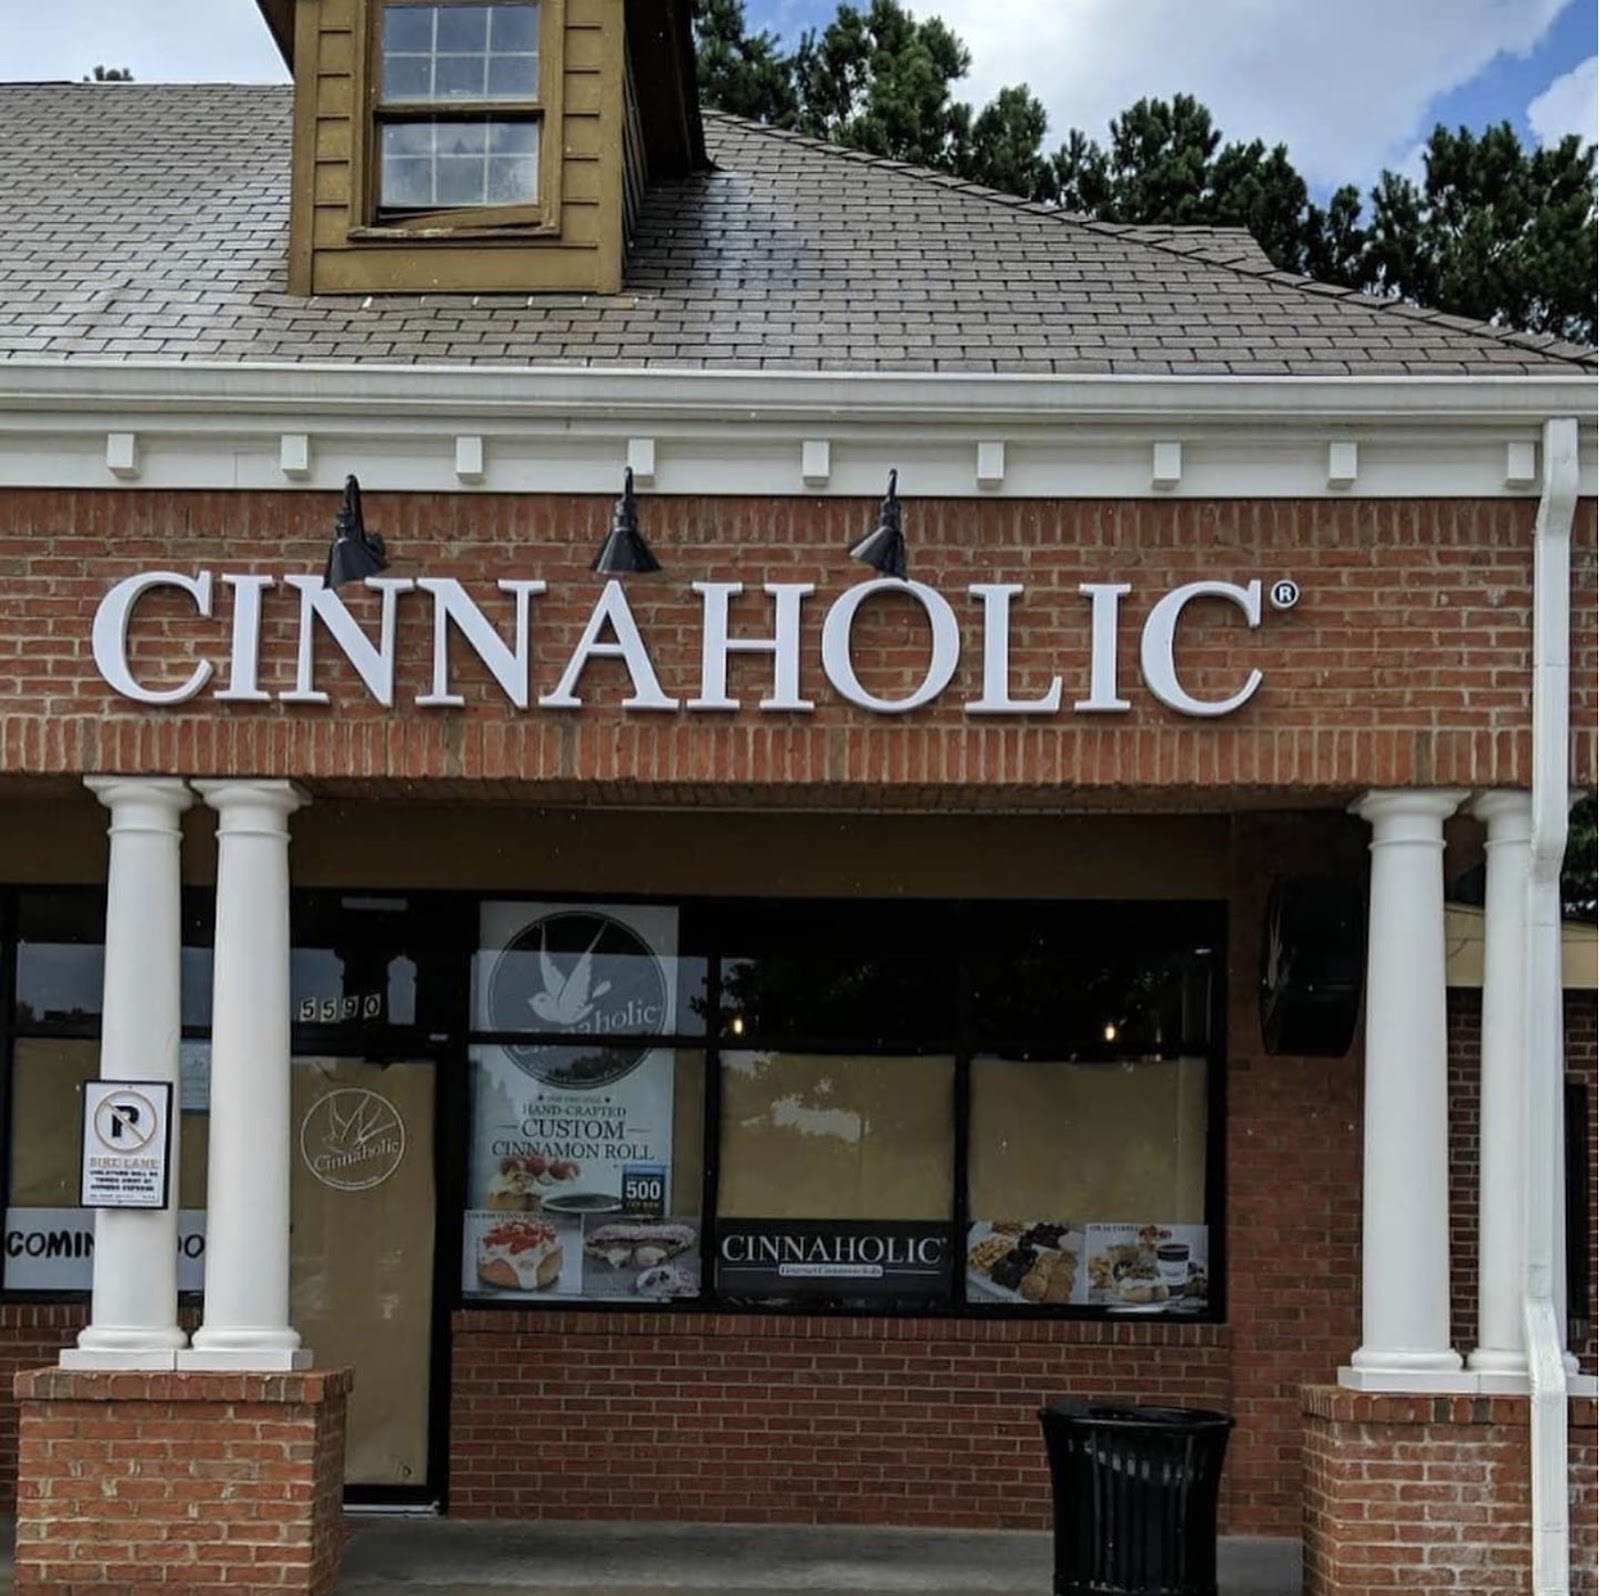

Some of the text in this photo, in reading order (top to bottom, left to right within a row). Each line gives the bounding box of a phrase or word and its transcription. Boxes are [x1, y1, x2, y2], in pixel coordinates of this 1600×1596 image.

[301, 995, 380, 1020] 5590
[521, 1104, 627, 1117] HAND-CRAFTED
[521, 1118, 625, 1140] CUSTOM
[491, 1139, 655, 1161] CINNAMON ROLL
[626, 1180, 661, 1200] 500
[7, 1231, 95, 1258] COMIN
